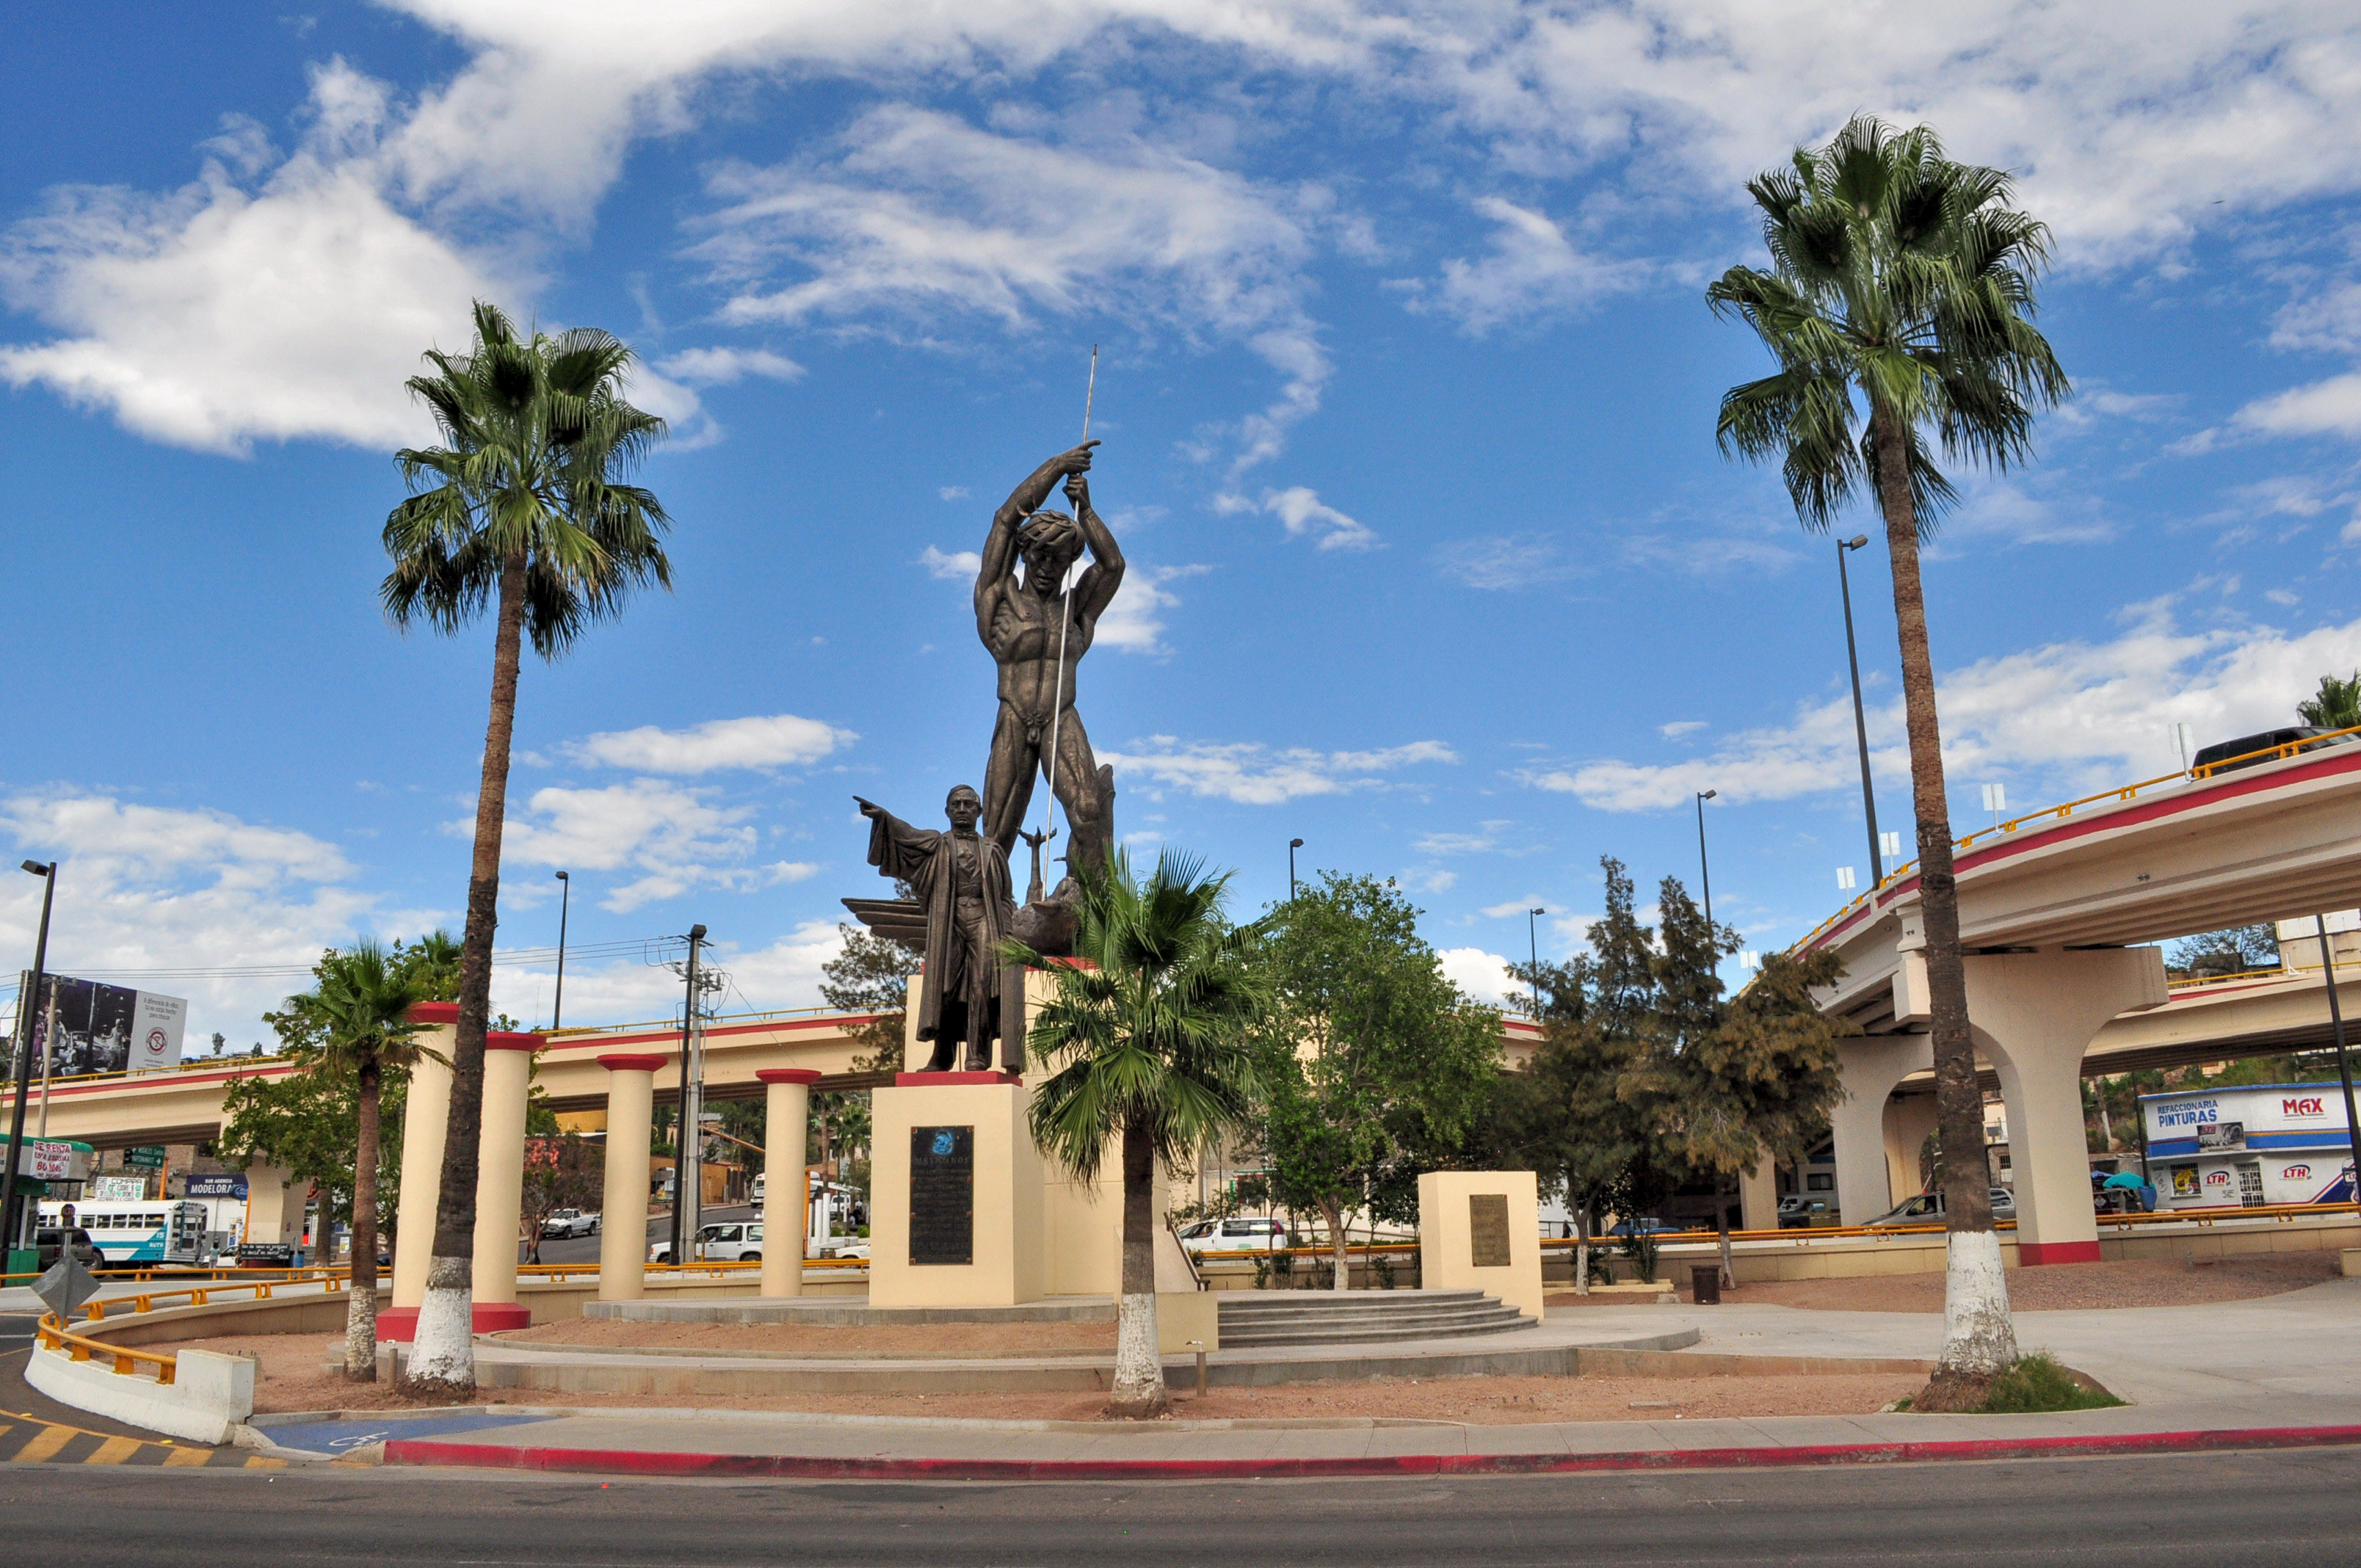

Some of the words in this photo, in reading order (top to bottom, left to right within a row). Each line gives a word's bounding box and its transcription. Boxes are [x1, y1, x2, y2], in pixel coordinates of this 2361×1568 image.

[2158, 1100, 2218, 1114] REFACCIONARIA
[2282, 1098, 2324, 1117] MAX
[2158, 1108, 2217, 1128] PINTURAS
[46, 1144, 71, 1153] RENTA
[37, 1161, 47, 1171] 80
[2284, 1168, 2306, 1178] LTH
[2207, 1175, 2226, 1185] LTH
